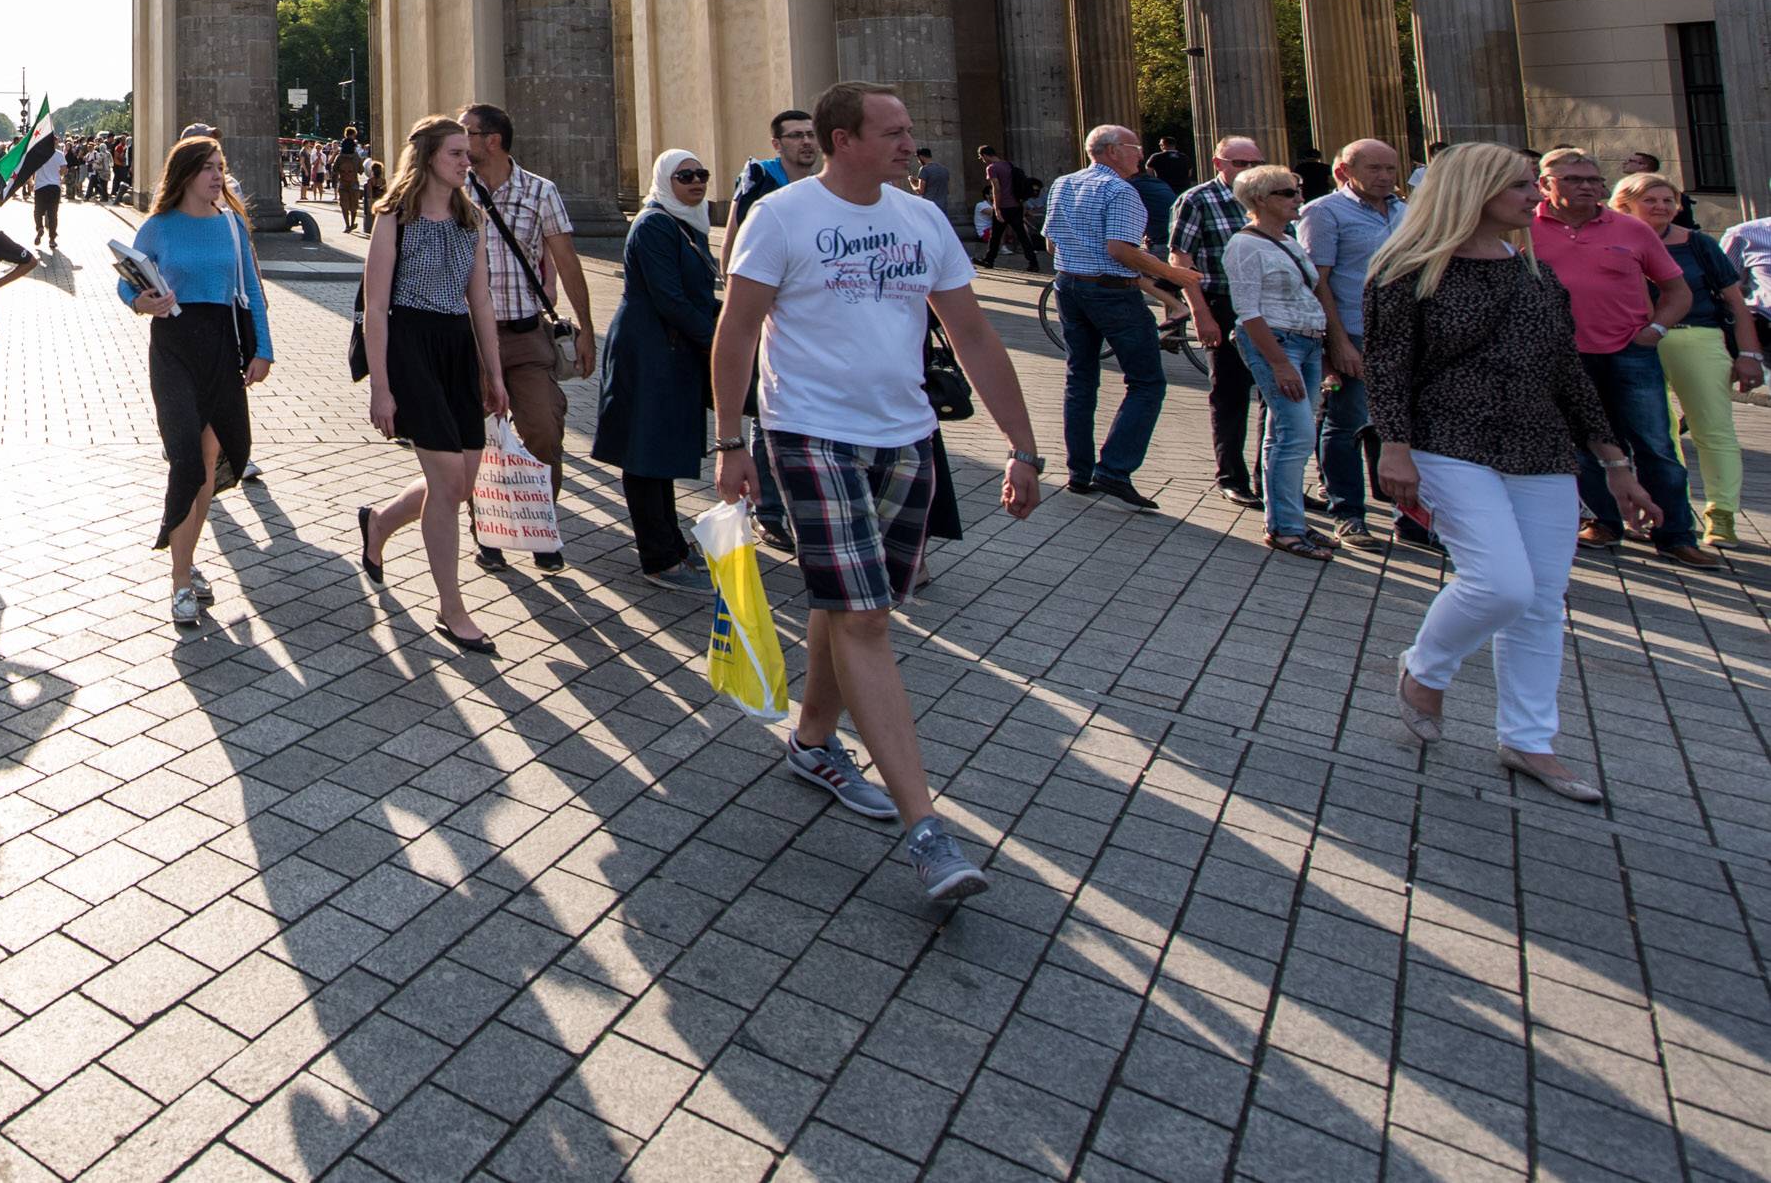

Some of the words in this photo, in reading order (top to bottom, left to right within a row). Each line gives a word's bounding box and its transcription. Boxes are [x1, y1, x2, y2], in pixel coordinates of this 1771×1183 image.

[816, 225, 898, 264] Denim
[866, 239, 927, 303] Goods
[513, 489, 551, 505] König
[522, 525, 558, 540] König
